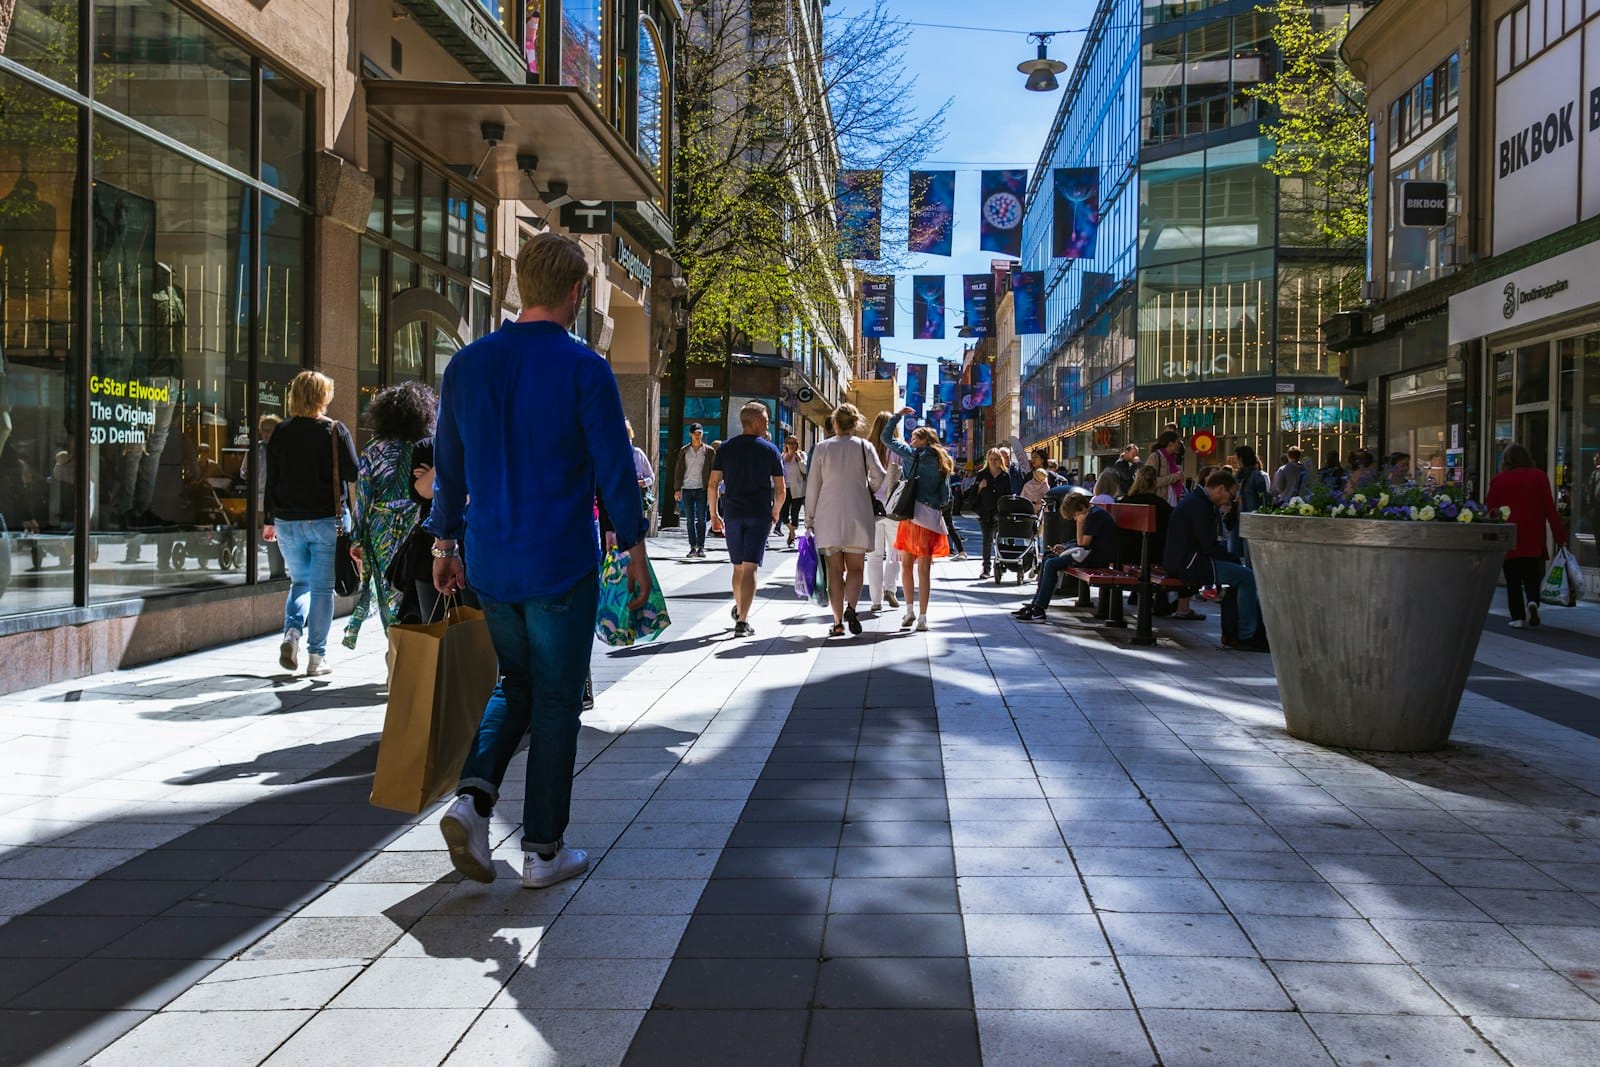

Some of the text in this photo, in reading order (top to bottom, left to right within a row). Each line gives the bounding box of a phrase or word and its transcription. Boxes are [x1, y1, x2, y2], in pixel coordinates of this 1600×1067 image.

[574, 208, 607, 229] T
[90, 375, 168, 402] G-Star Elwood
[90, 401, 156, 426] The Original
[90, 426, 145, 444] 3D Denim
